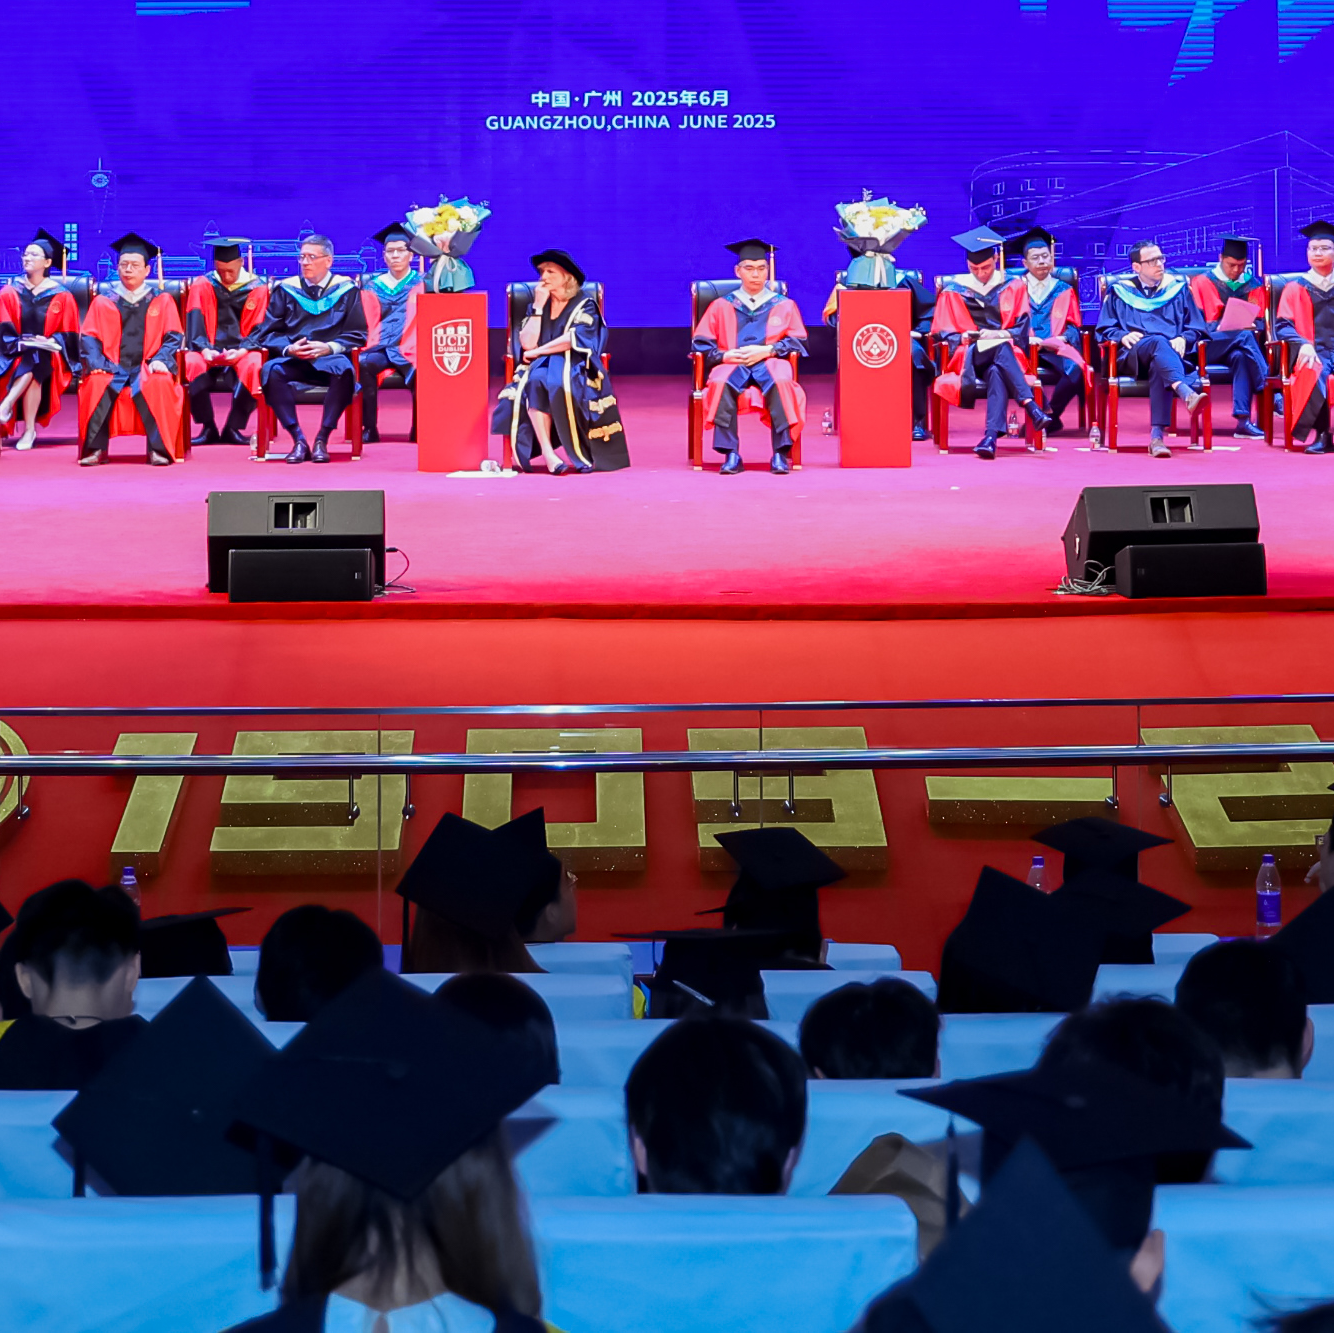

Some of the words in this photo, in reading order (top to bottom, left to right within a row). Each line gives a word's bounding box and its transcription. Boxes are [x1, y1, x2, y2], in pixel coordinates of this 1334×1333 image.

[530, 89, 622, 108] 中国·广州
[631, 89, 730, 107] 2025年6月
[485, 114, 670, 132] GUANGZHOU,CHINA
[678, 114, 728, 129] JUNE
[732, 114, 775, 129] 2025
[437, 335, 467, 347] UCD
